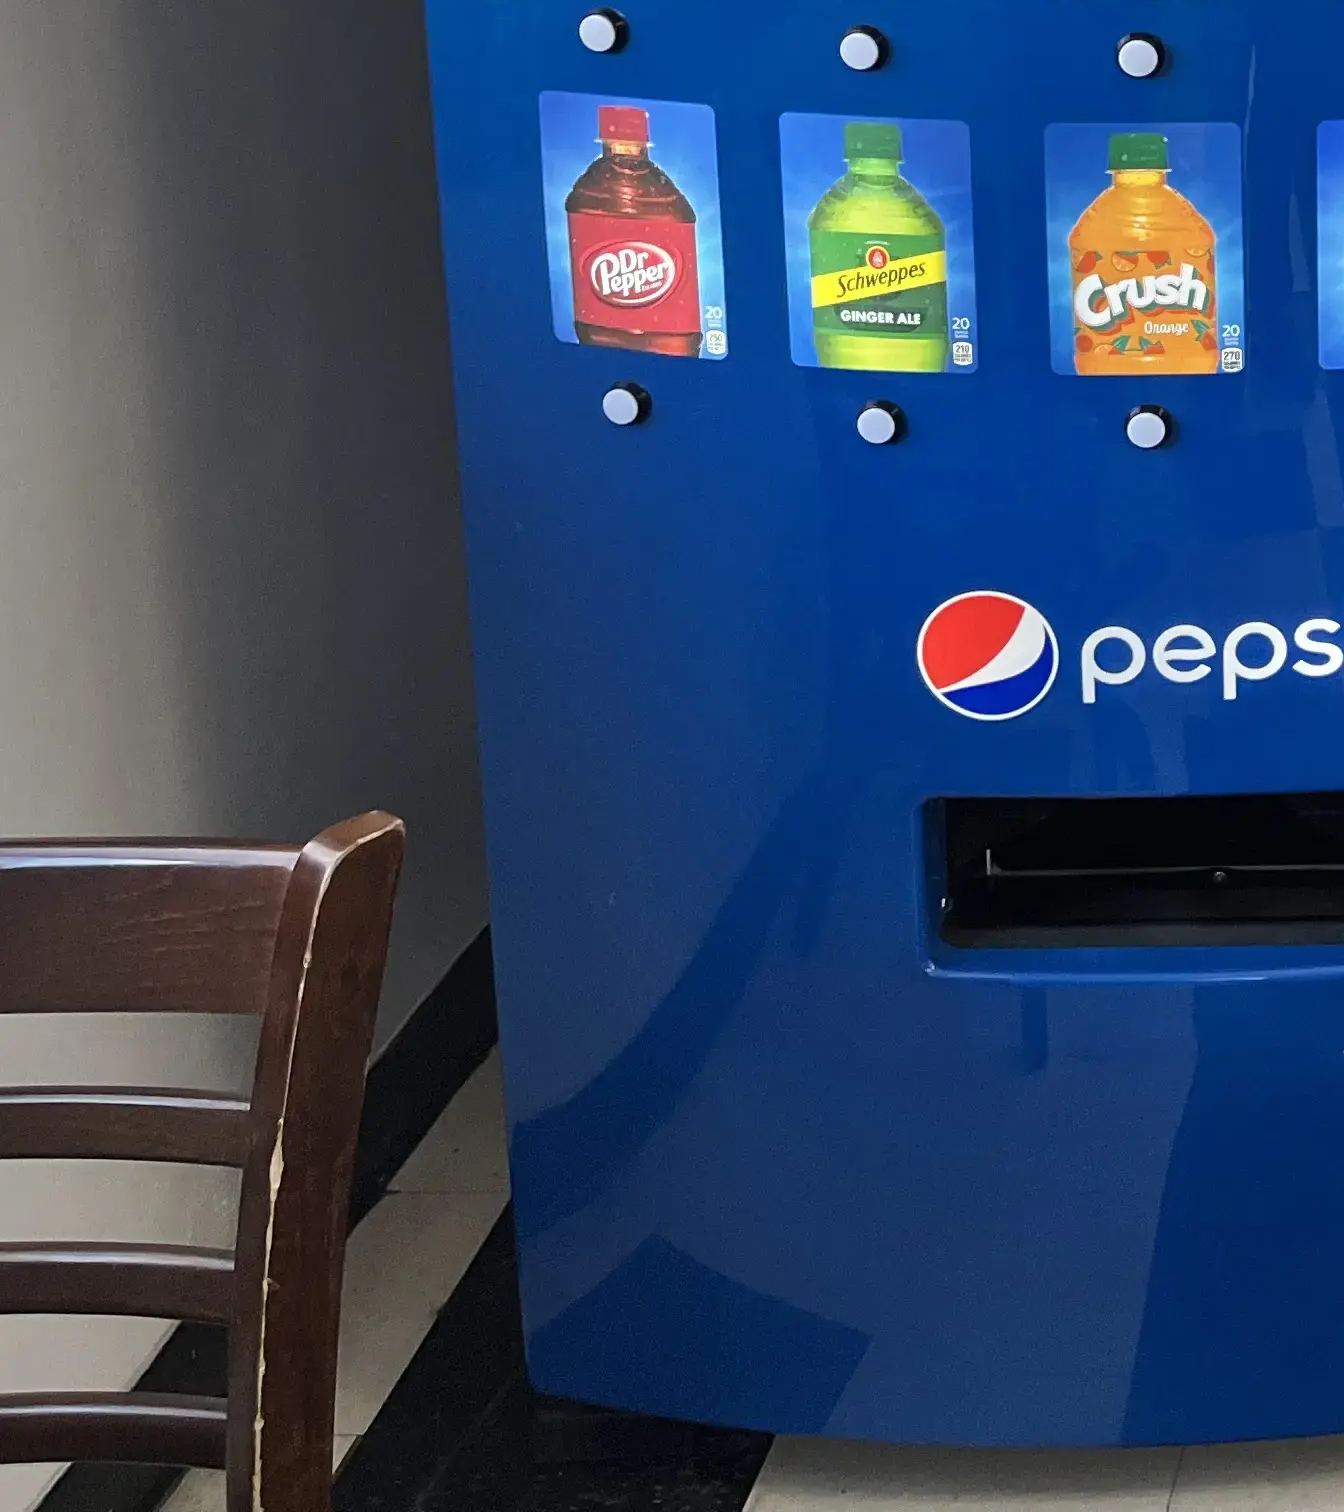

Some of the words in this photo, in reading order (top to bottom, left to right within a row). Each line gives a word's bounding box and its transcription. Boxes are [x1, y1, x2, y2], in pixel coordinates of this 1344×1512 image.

[618, 248, 649, 274] Dr
[600, 252, 670, 297] Pepper
[836, 262, 926, 299] Schweppes
[1074, 263, 1210, 328] Crush
[704, 305, 723, 319] 20
[840, 309, 895, 324] GINGER
[896, 312, 921, 325] ALE
[952, 317, 970, 330] 20
[1143, 321, 1189, 336] Orange
[1221, 324, 1240, 337] 20
[955, 344, 970, 354] 210
[1223, 351, 1241, 361] 270
